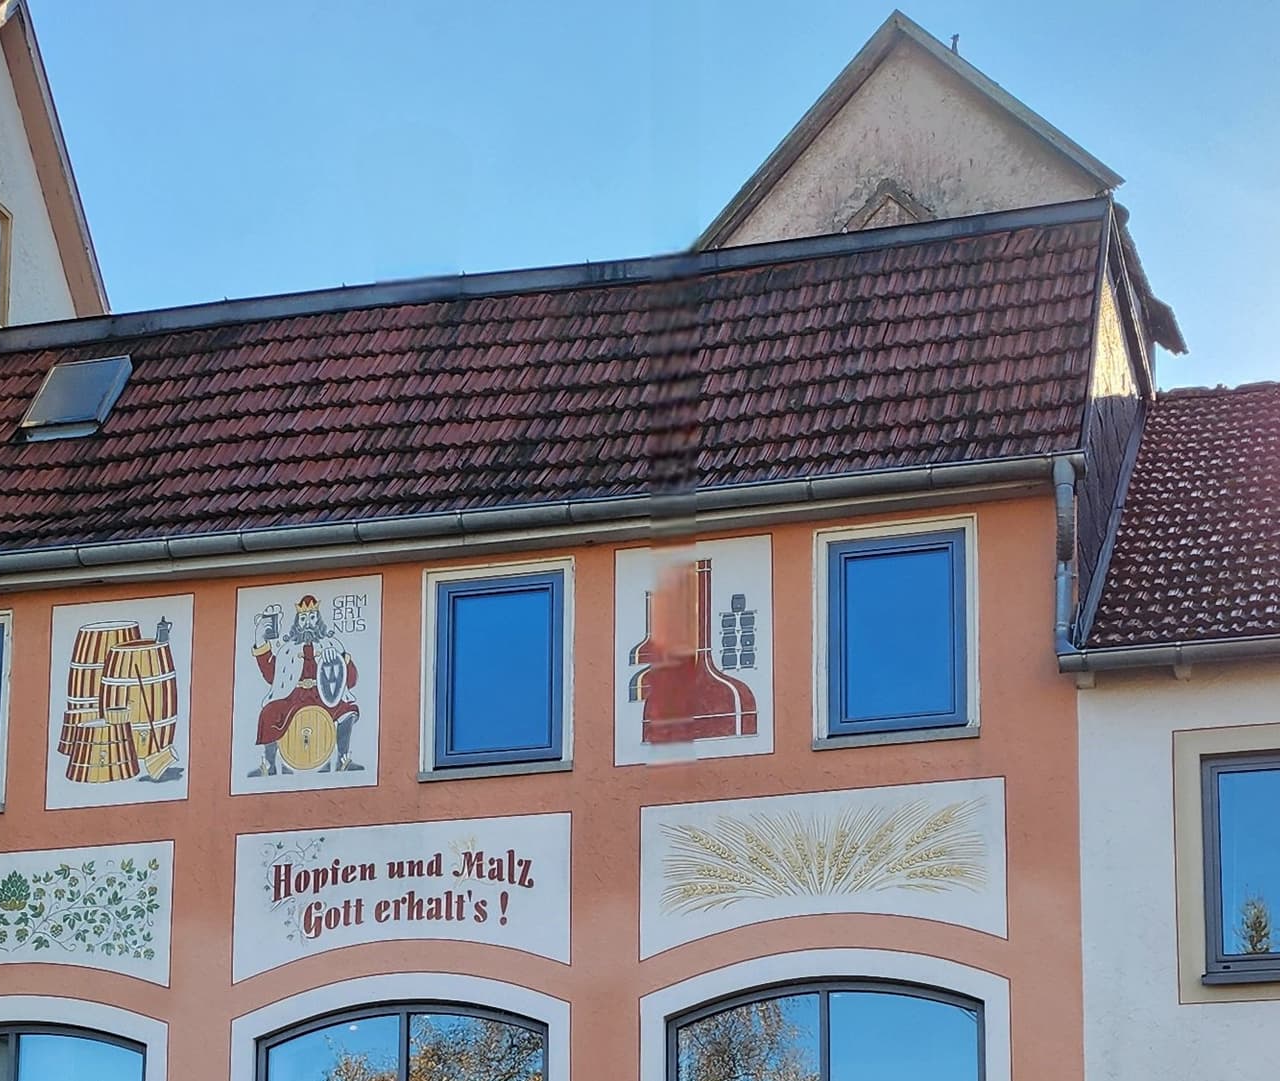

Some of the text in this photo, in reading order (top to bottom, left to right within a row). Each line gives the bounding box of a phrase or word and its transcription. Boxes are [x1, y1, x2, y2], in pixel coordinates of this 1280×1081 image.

[332, 594, 367, 608] GAM
[332, 606, 361, 620] BRI
[332, 618, 366, 633] NUS
[272, 849, 535, 902] Hopfen und Malz
[303, 897, 365, 939] Gott
[374, 890, 488, 924] erhalt's
